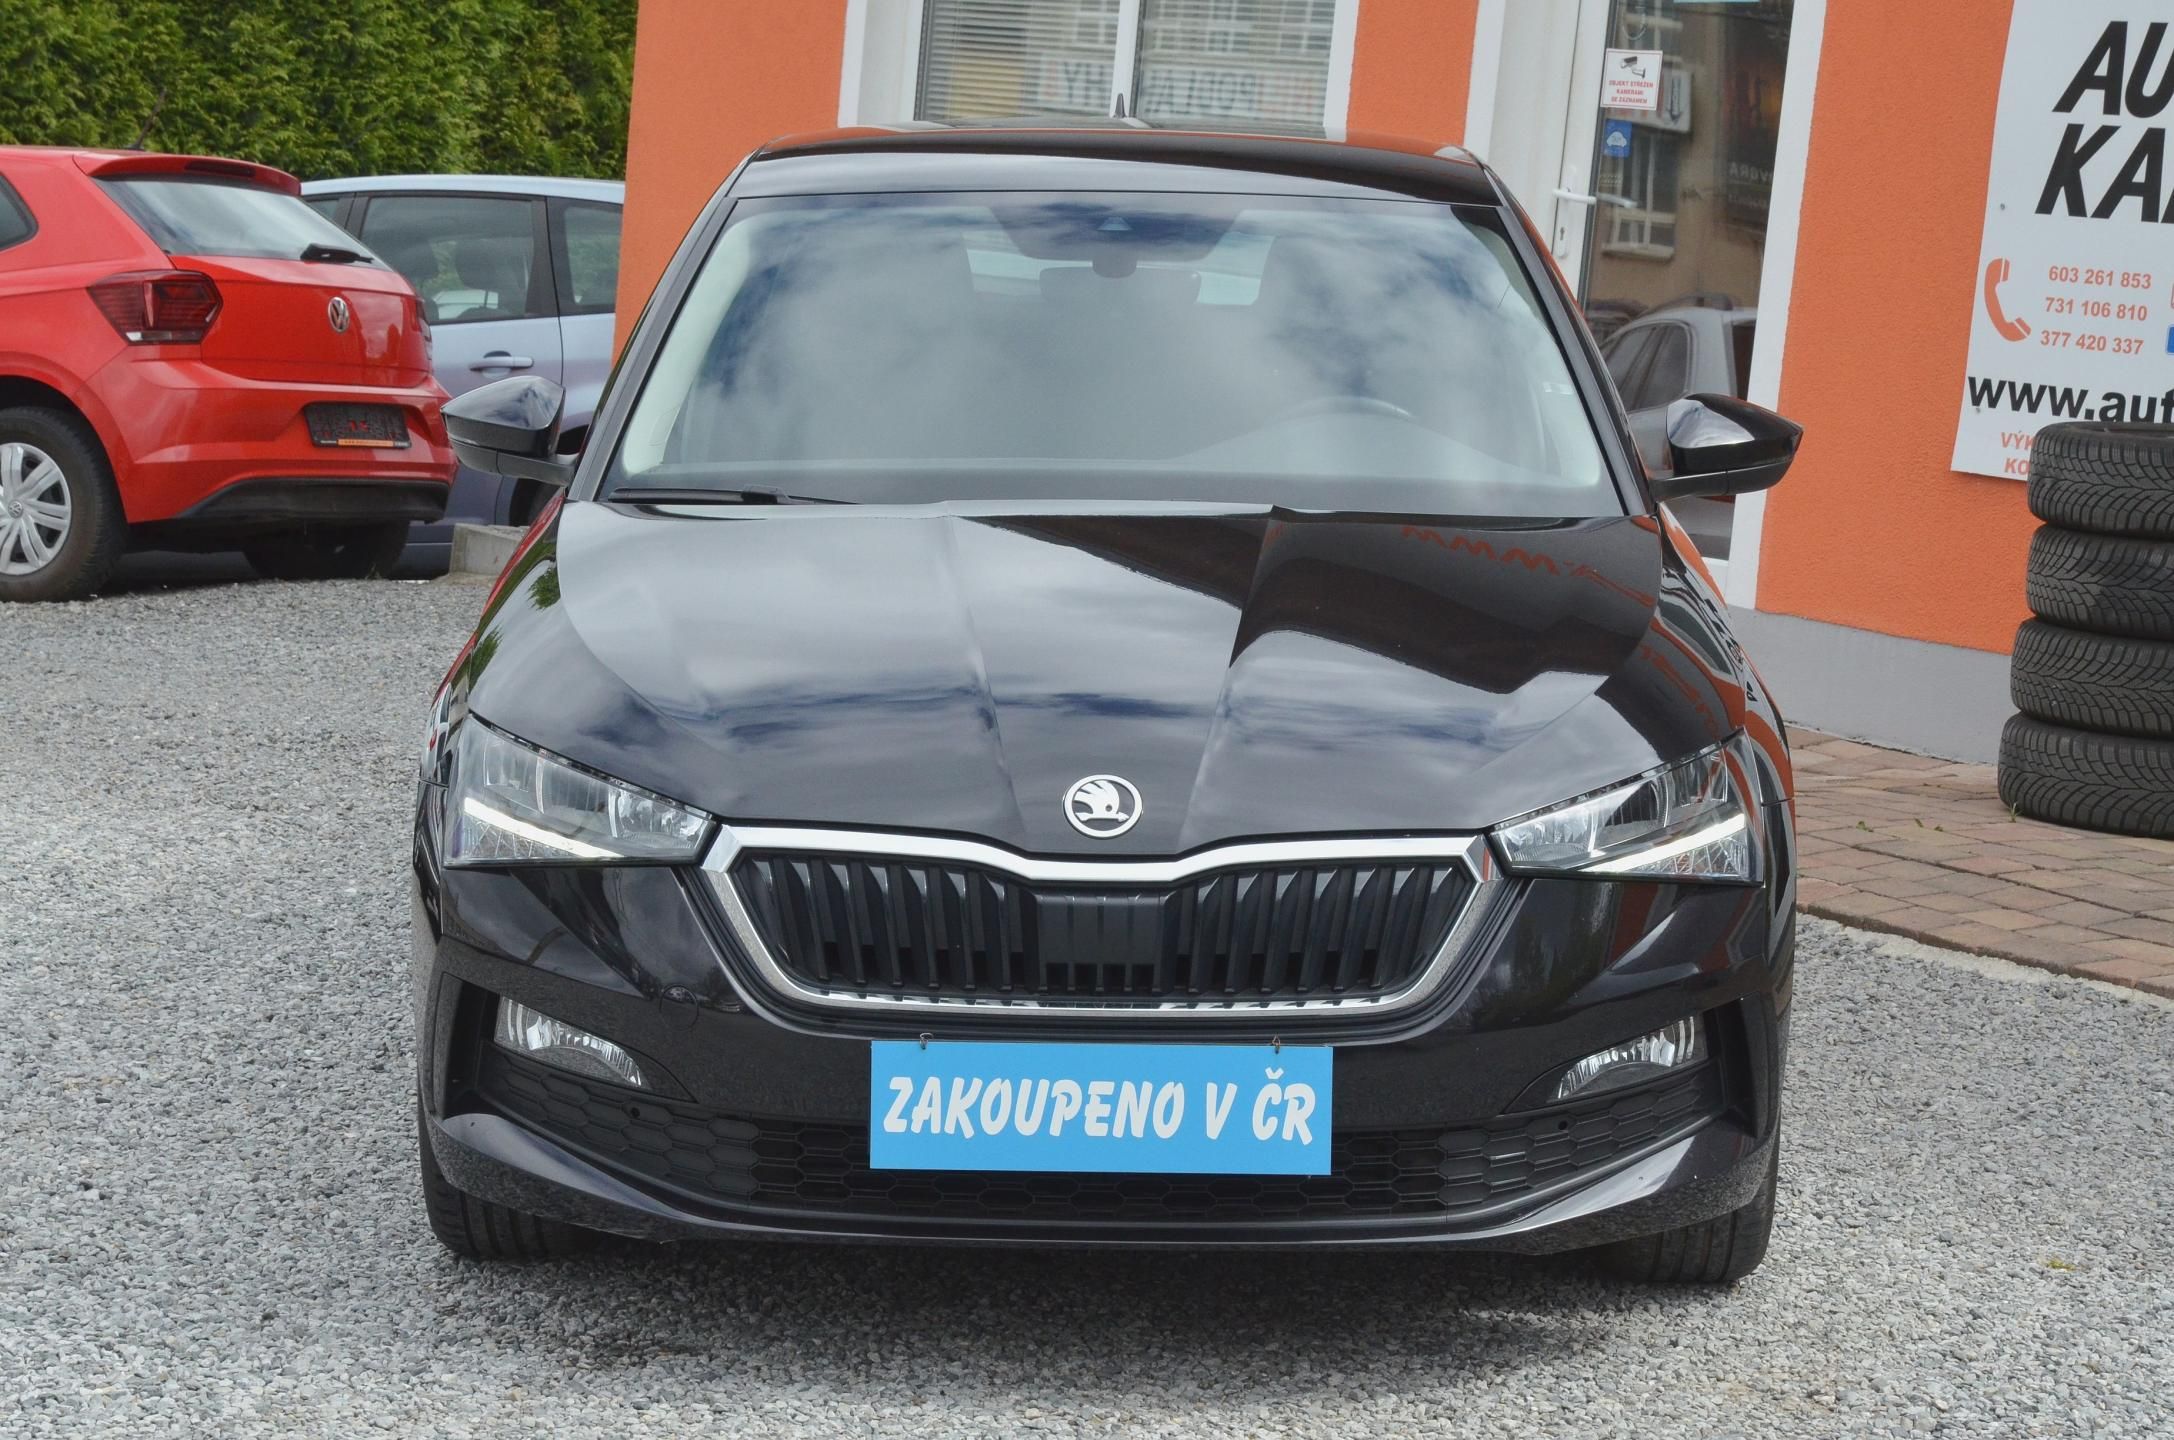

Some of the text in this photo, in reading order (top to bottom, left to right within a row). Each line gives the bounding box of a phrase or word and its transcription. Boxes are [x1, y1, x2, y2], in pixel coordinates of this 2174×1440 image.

[2052, 20, 2174, 119] AU
[2035, 123, 2174, 224] KA
[2048, 265, 2152, 290] 603 261 853
[2045, 296, 2148, 321] 731 106 810
[2040, 329, 2144, 355] 377 420 337
[883, 1067, 1316, 1145] ZAKOUPENO V ČR
